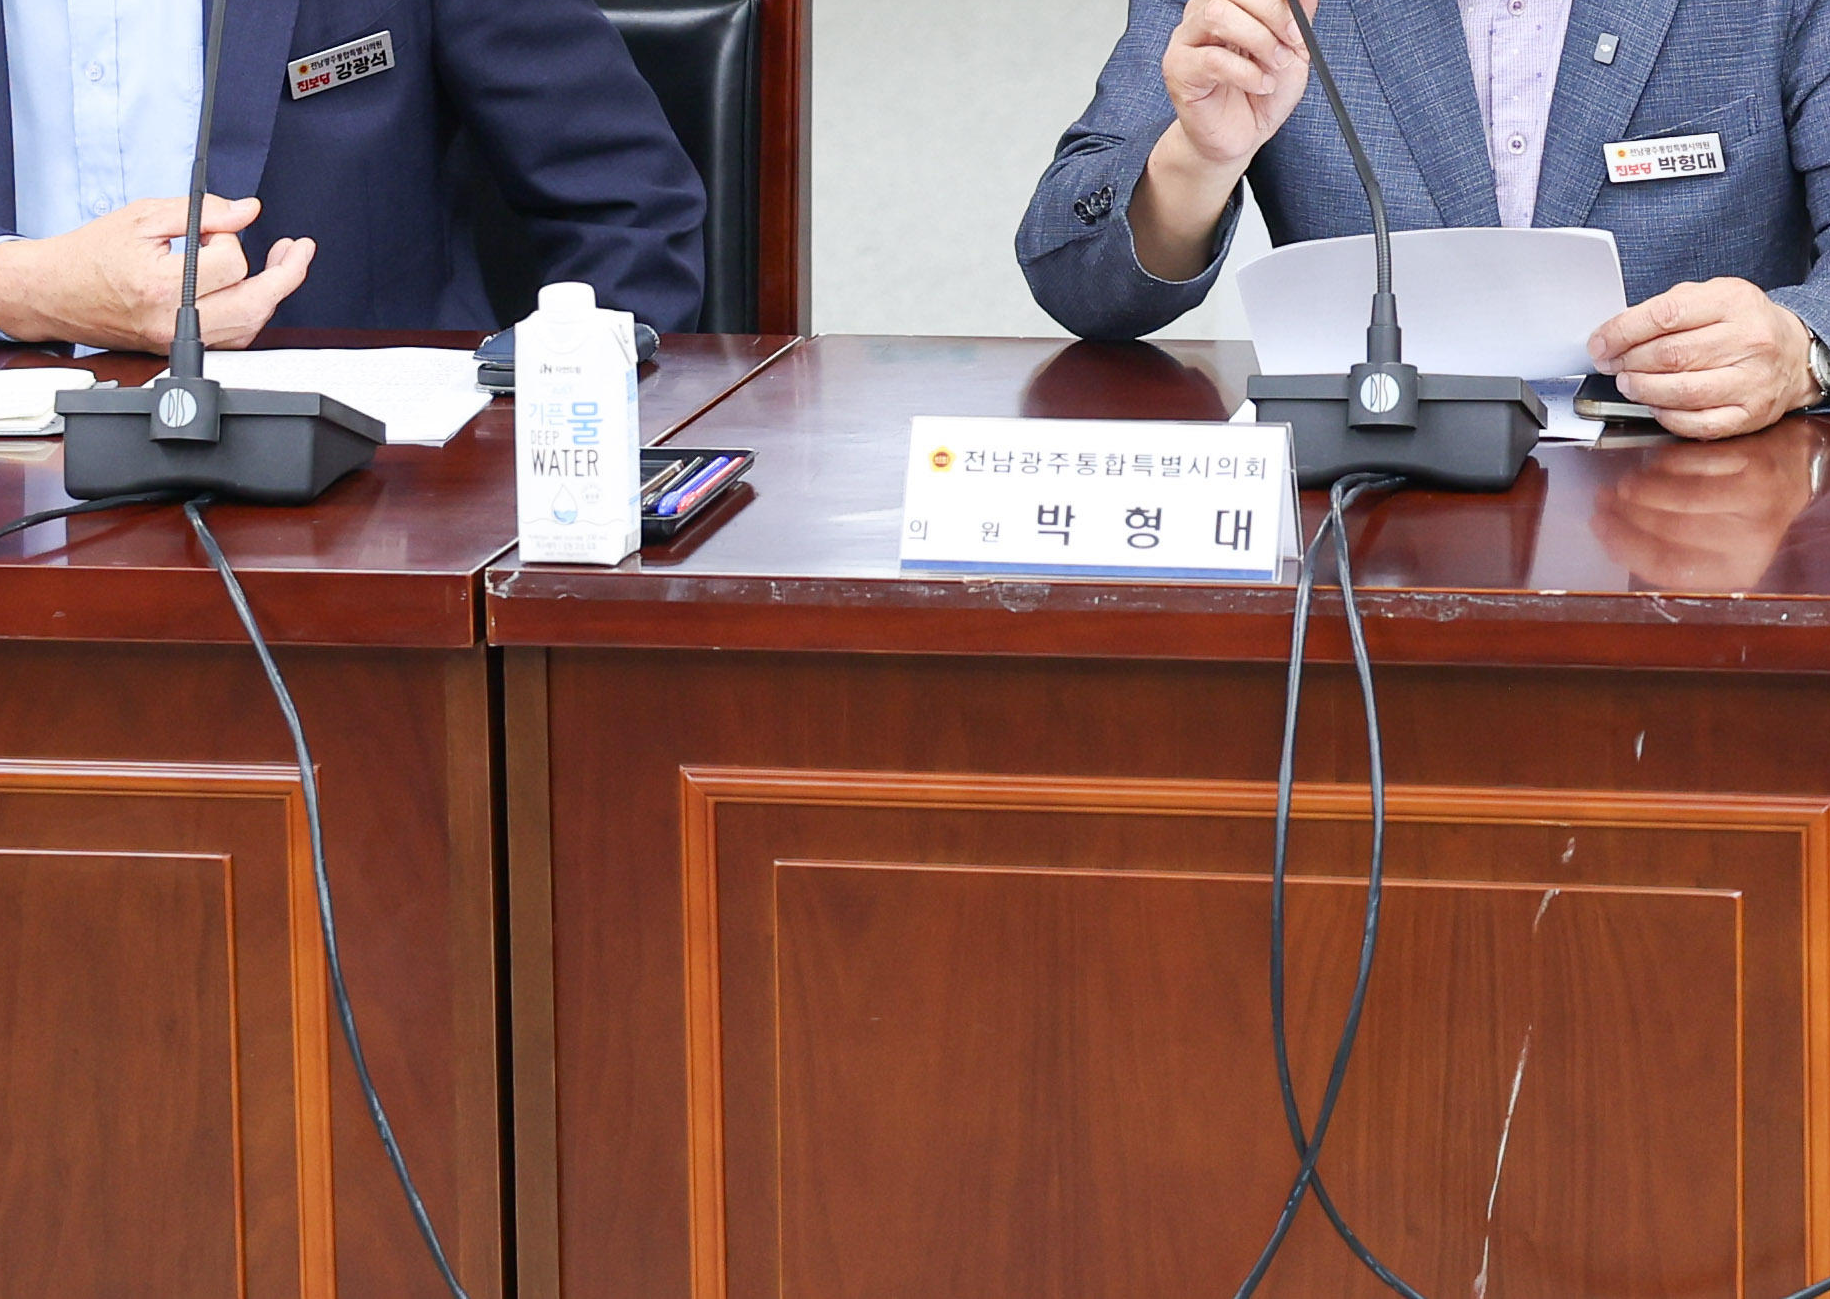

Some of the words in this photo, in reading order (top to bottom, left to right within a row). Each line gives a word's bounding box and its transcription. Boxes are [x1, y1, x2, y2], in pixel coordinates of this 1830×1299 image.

[296, 72, 332, 93] 진보당
[335, 50, 388, 80] 강광석
[1615, 162, 1653, 177] 진보당
[1658, 152, 1717, 173] 박형대
[529, 403, 565, 426] 기픈
[567, 402, 603, 445] 물
[531, 430, 560, 446] DEEP
[531, 449, 599, 477] WATER
[964, 450, 1266, 481] 전남광주통합특별시의회
